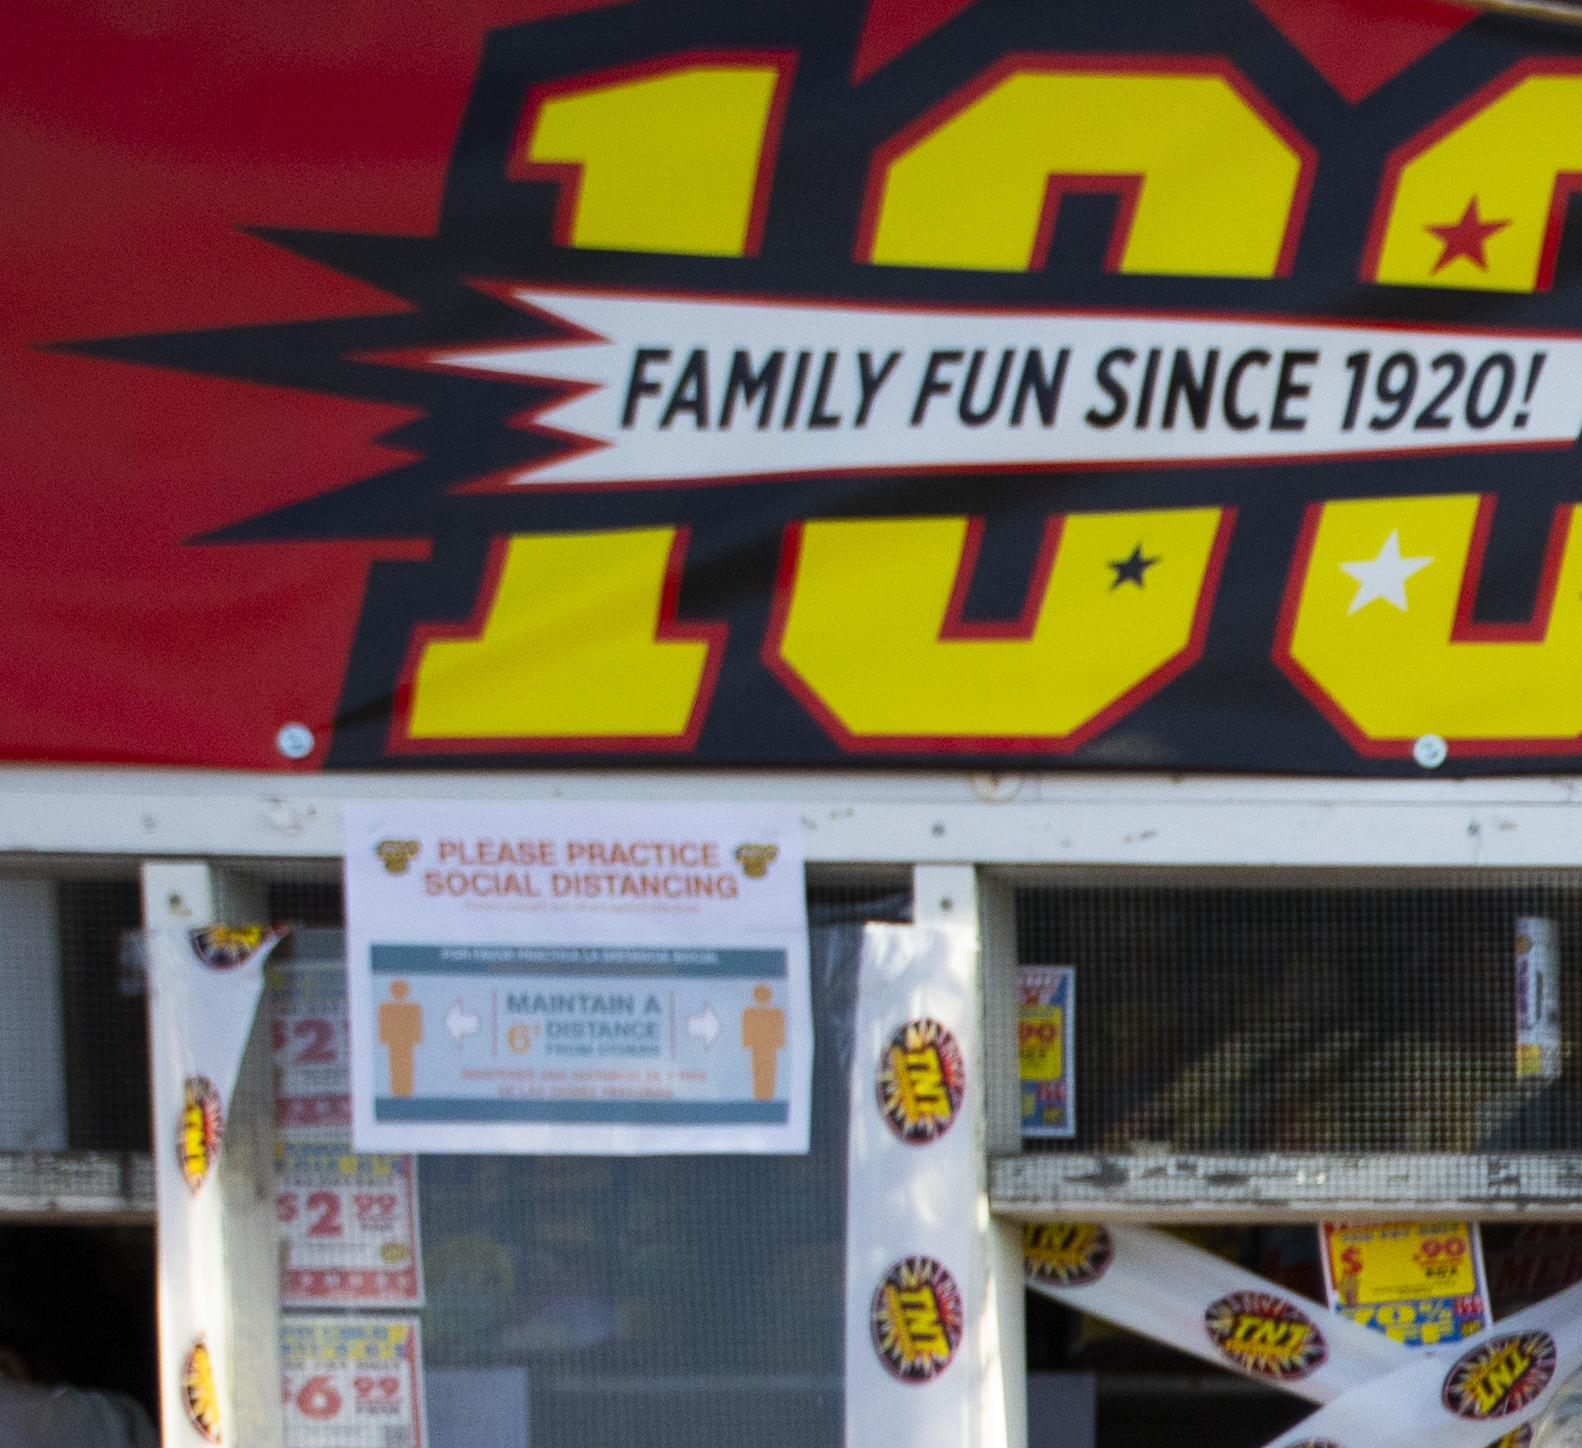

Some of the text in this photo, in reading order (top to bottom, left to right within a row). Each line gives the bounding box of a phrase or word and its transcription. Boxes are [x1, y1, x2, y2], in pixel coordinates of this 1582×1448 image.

[619, 347, 1548, 431] FAMILY FUN SINCE 1920!
[437, 839, 721, 868] PLEASE PRACTICE
[424, 871, 739, 900] SOCIAL DISTANCING
